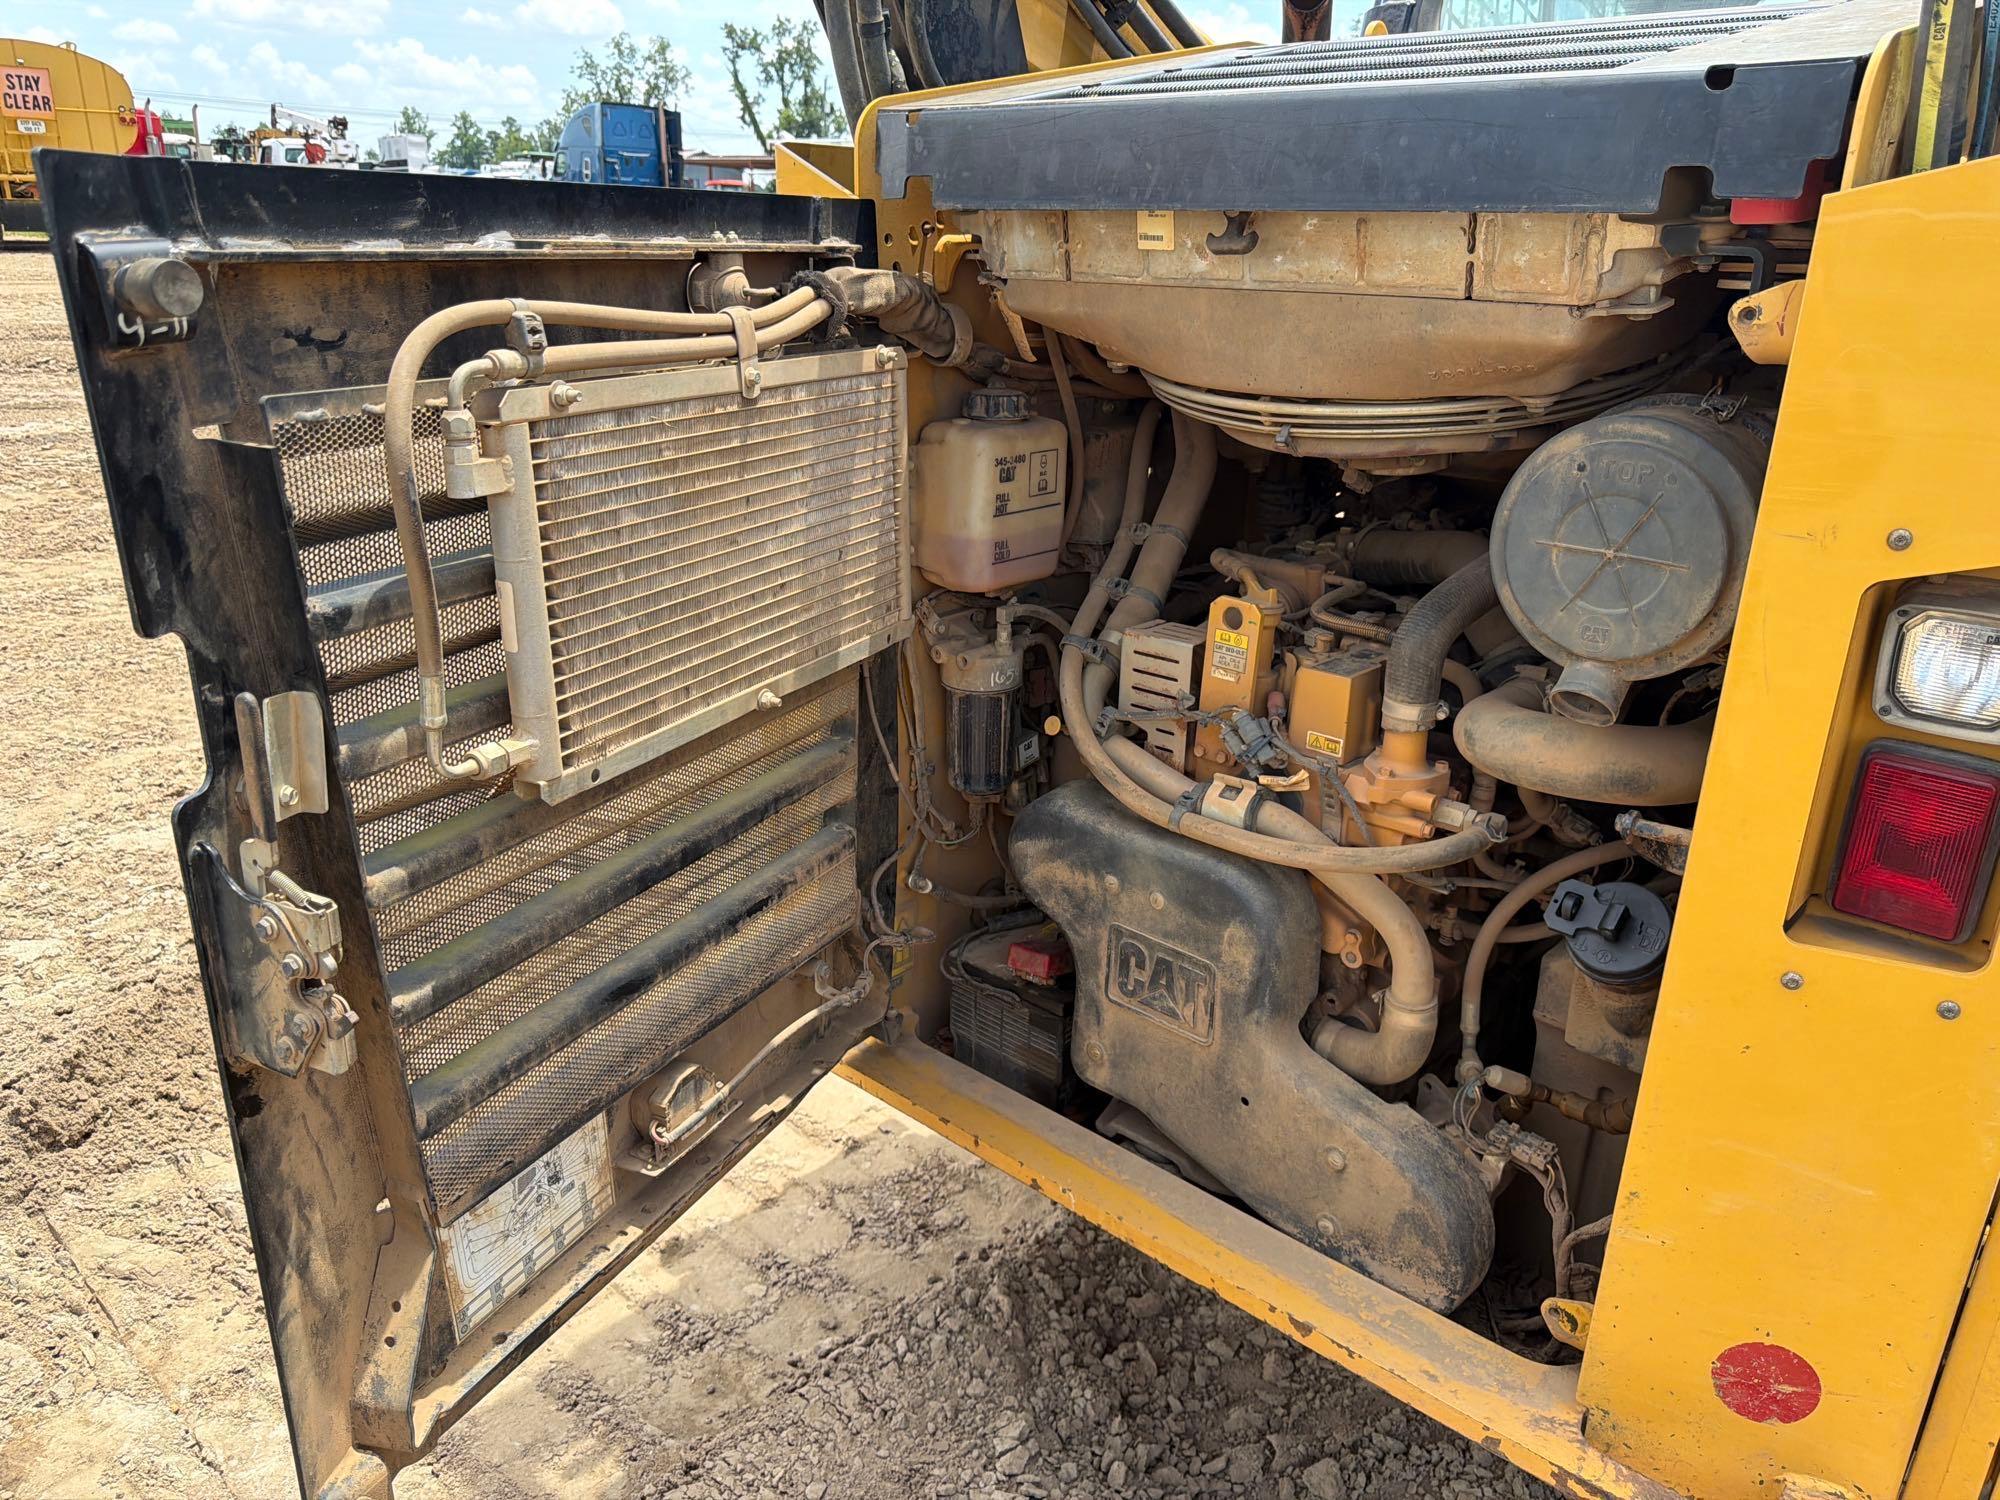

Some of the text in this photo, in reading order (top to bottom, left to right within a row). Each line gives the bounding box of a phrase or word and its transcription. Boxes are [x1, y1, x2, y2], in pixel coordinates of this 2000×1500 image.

[1988, 0, 2000, 33] 1E402
[1933, 22, 1947, 41] CAT
[5, 73, 40, 92] STAY
[3, 92, 52, 112] CLEAR
[999, 466, 1016, 484] CAT
[1600, 458, 1655, 486] TOP
[996, 493, 1011, 504] FULL
[995, 503, 1008, 515] HOT
[994, 538, 1009, 551] FULL
[994, 550, 1011, 562] COLD
[1580, 624, 1610, 644] CAT
[1986, 635, 2000, 645] CA
[1023, 740, 1033, 752] CAT
[1117, 940, 1209, 1030] CAT
